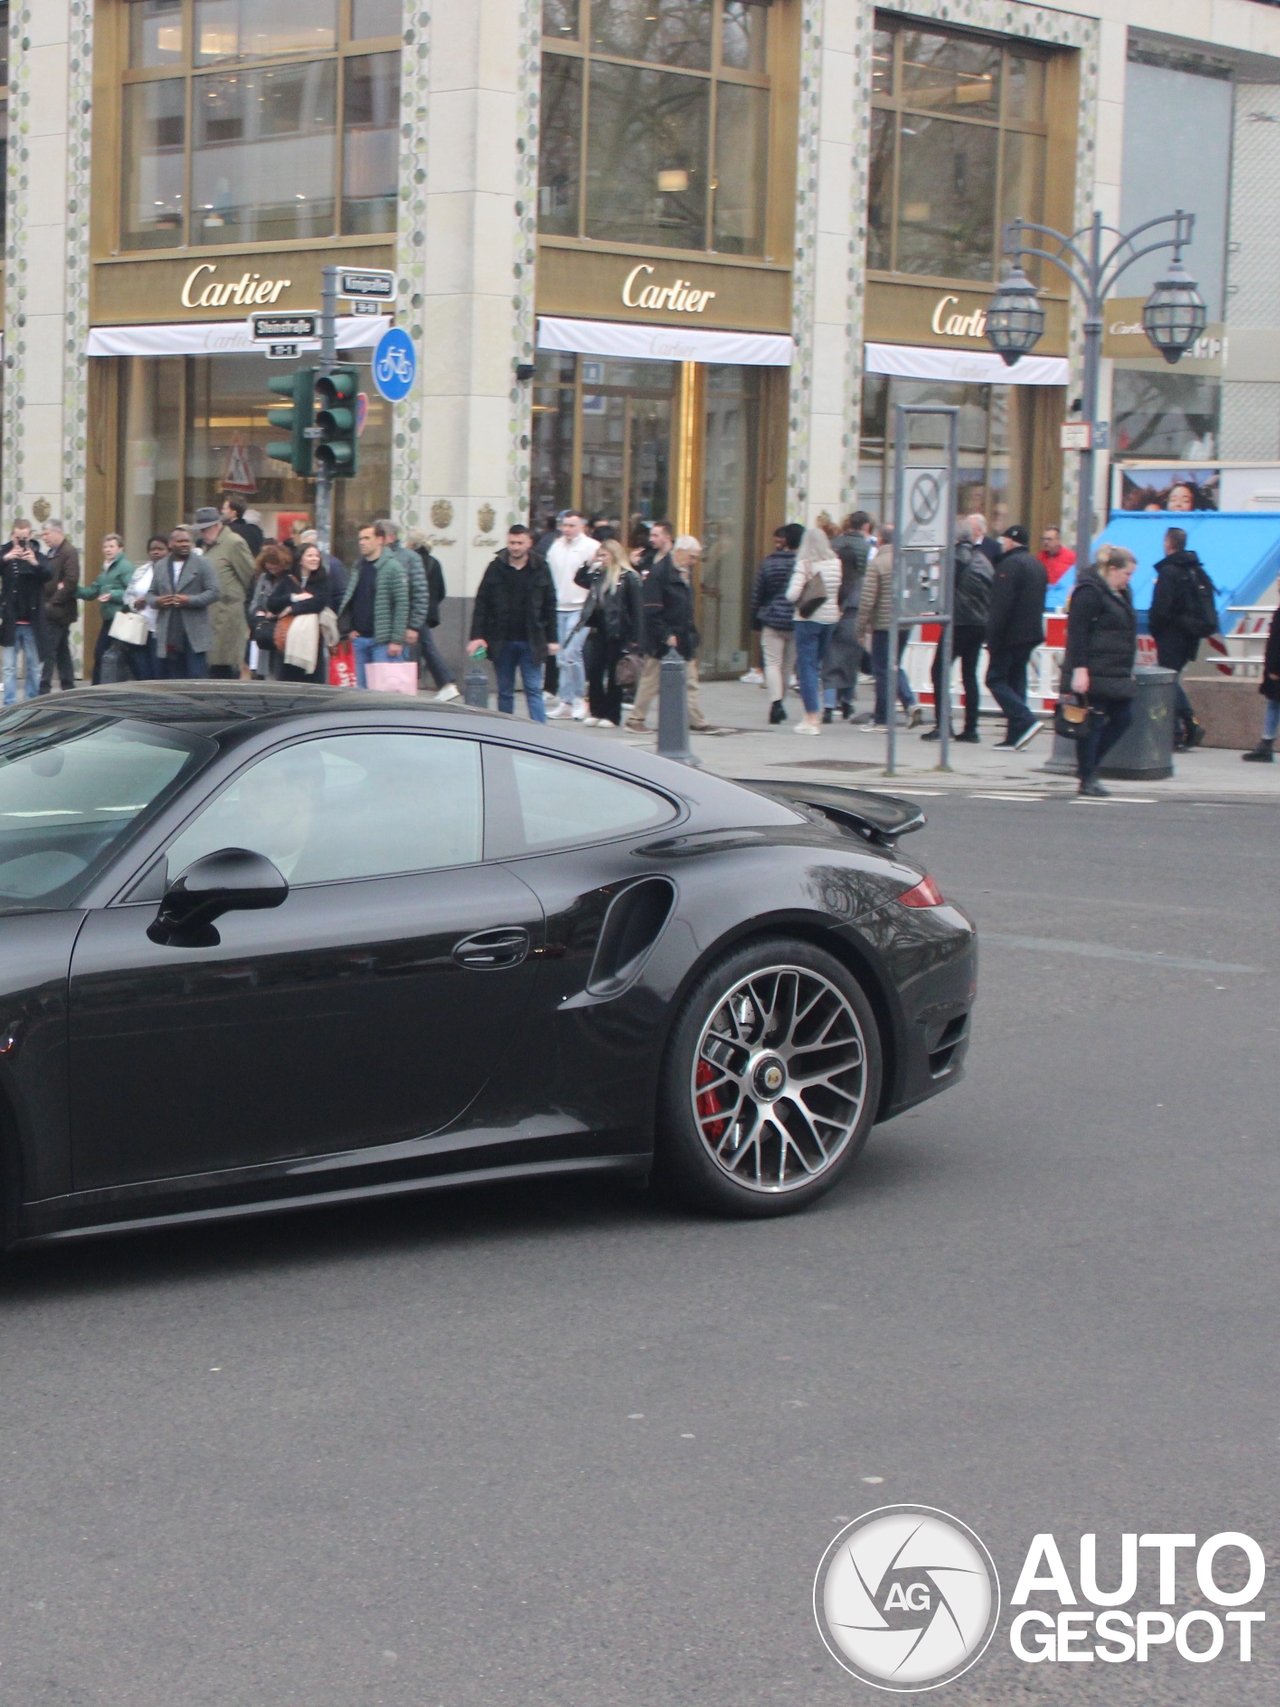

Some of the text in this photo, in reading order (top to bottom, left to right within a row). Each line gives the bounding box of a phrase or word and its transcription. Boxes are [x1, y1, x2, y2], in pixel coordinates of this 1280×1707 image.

[181, 264, 291, 308] Cartier
[622, 264, 716, 313] Cartier
[931, 296, 987, 337] Carti
